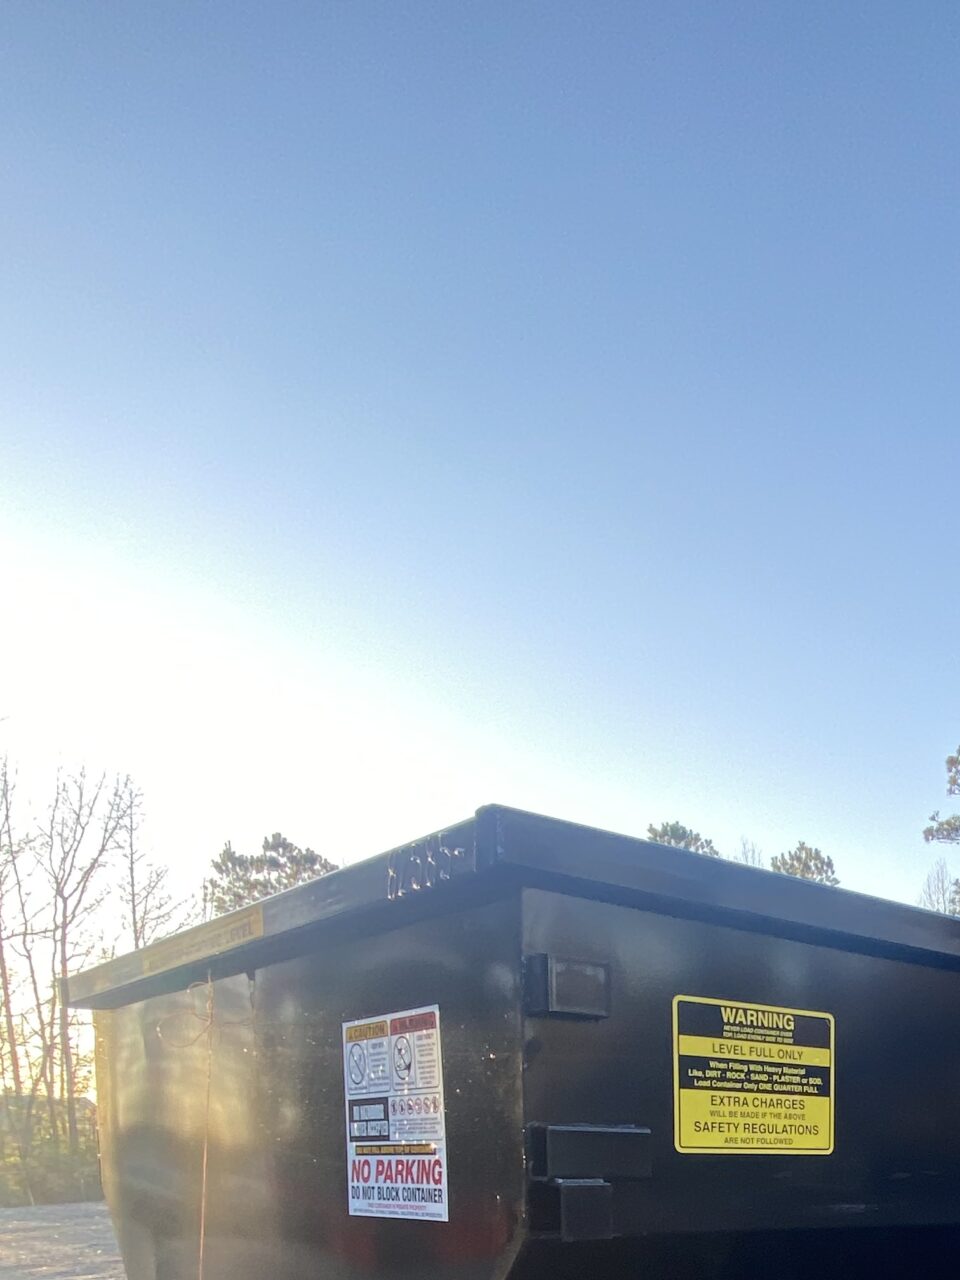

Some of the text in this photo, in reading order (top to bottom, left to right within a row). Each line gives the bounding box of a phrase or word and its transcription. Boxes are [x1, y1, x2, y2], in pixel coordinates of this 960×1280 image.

[720, 1006, 795, 1030] WARNING
[712, 1043, 803, 1060] LEVEL FULL ONLY
[709, 1060, 806, 1075] When Filling With Heavy Material
[705, 1070, 721, 1079] DIRT
[726, 1071, 745, 1080] ROCK
[751, 1073, 768, 1081] SAND
[773, 1075, 801, 1083] PLASTER
[694, 1078, 819, 1093] Load Container Only ONE QUARTER FULL
[710, 1095, 805, 1110] EXTRA CHARGES
[709, 1110, 726, 1118] WILL
[740, 1111, 759, 1119] MADE
[769, 1112, 781, 1120] THE
[784, 1113, 806, 1121] ABOVE
[694, 1121, 819, 1135] SAFETY REGULATIONS
[740, 1137, 754, 1145] NOT
[756, 1137, 793, 1145] FOLLOWED
[351, 1158, 442, 1186] NO PARKING
[351, 1185, 443, 1204] DO NOT BLOCK CONTAINER
